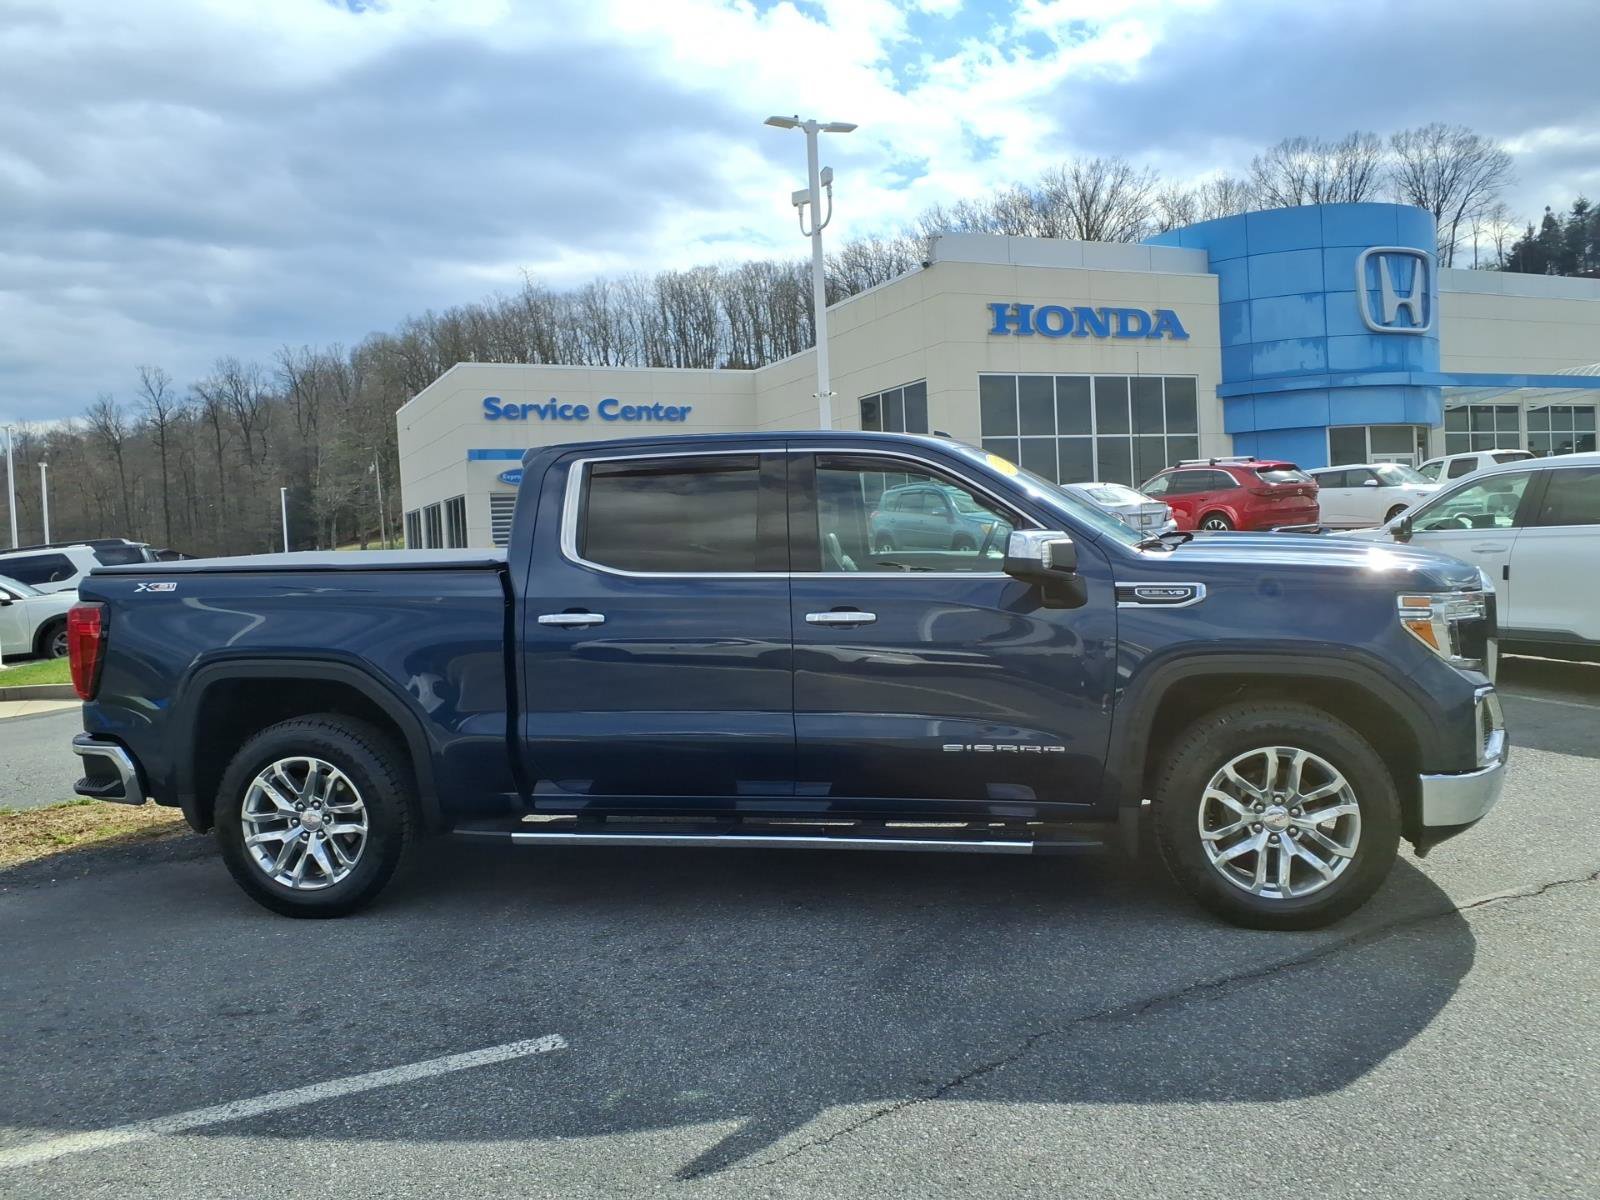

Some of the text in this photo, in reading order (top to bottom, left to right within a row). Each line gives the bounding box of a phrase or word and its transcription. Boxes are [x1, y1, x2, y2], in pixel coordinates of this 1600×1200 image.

[987, 303, 1190, 340] HONDA
[483, 397, 692, 422] Service Center
[942, 744, 1066, 753] SIERRA
